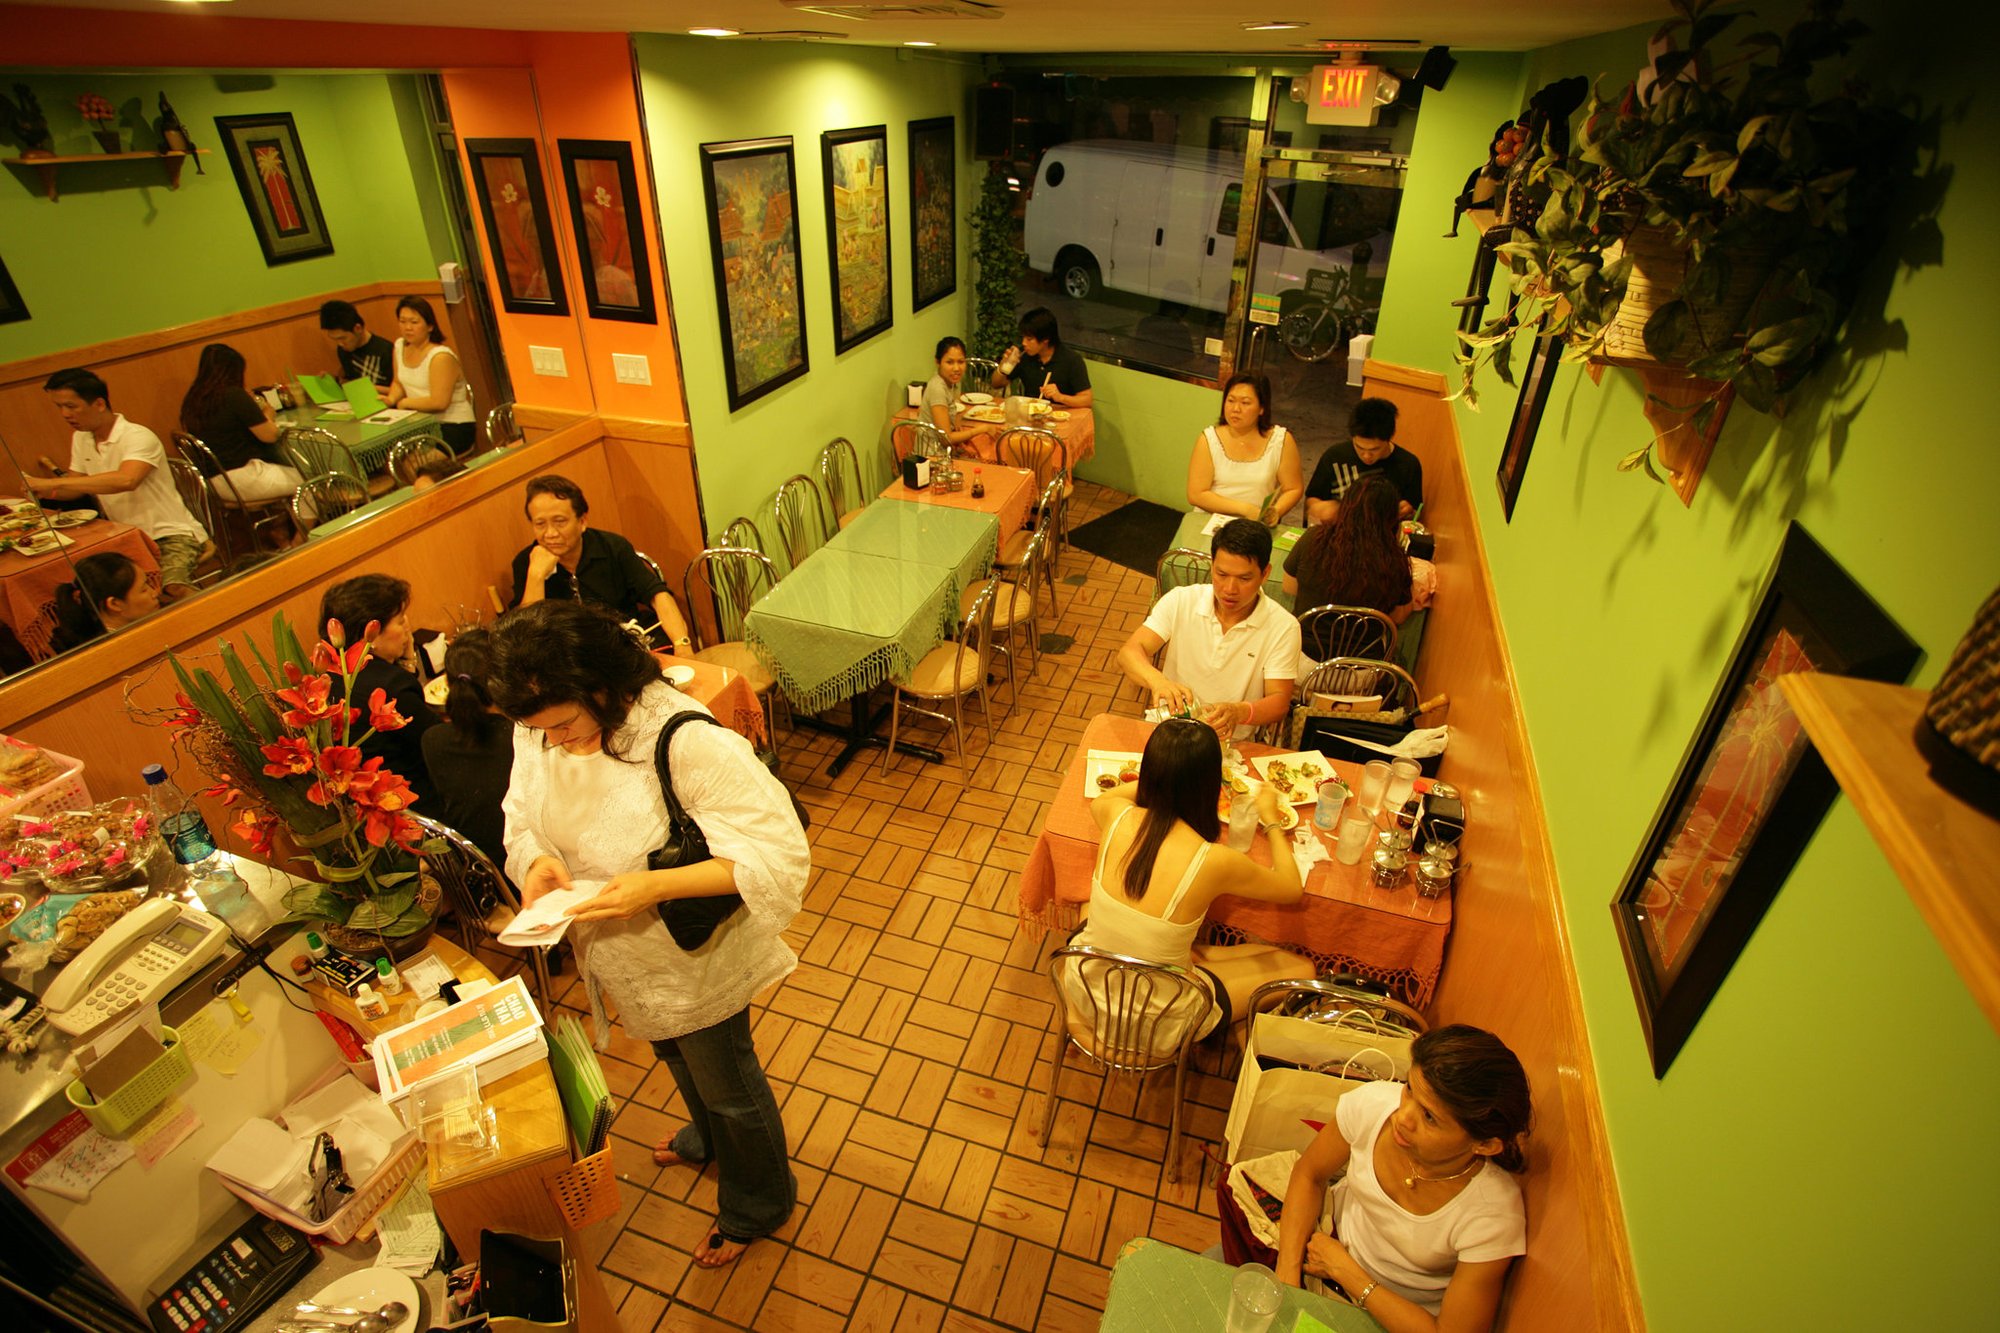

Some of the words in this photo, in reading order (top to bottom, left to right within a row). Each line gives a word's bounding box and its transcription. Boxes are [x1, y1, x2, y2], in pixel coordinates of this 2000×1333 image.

[1320, 69, 1368, 108] EXIT
[493, 999, 514, 1026] THAI
[504, 992, 527, 1021] CHAO
